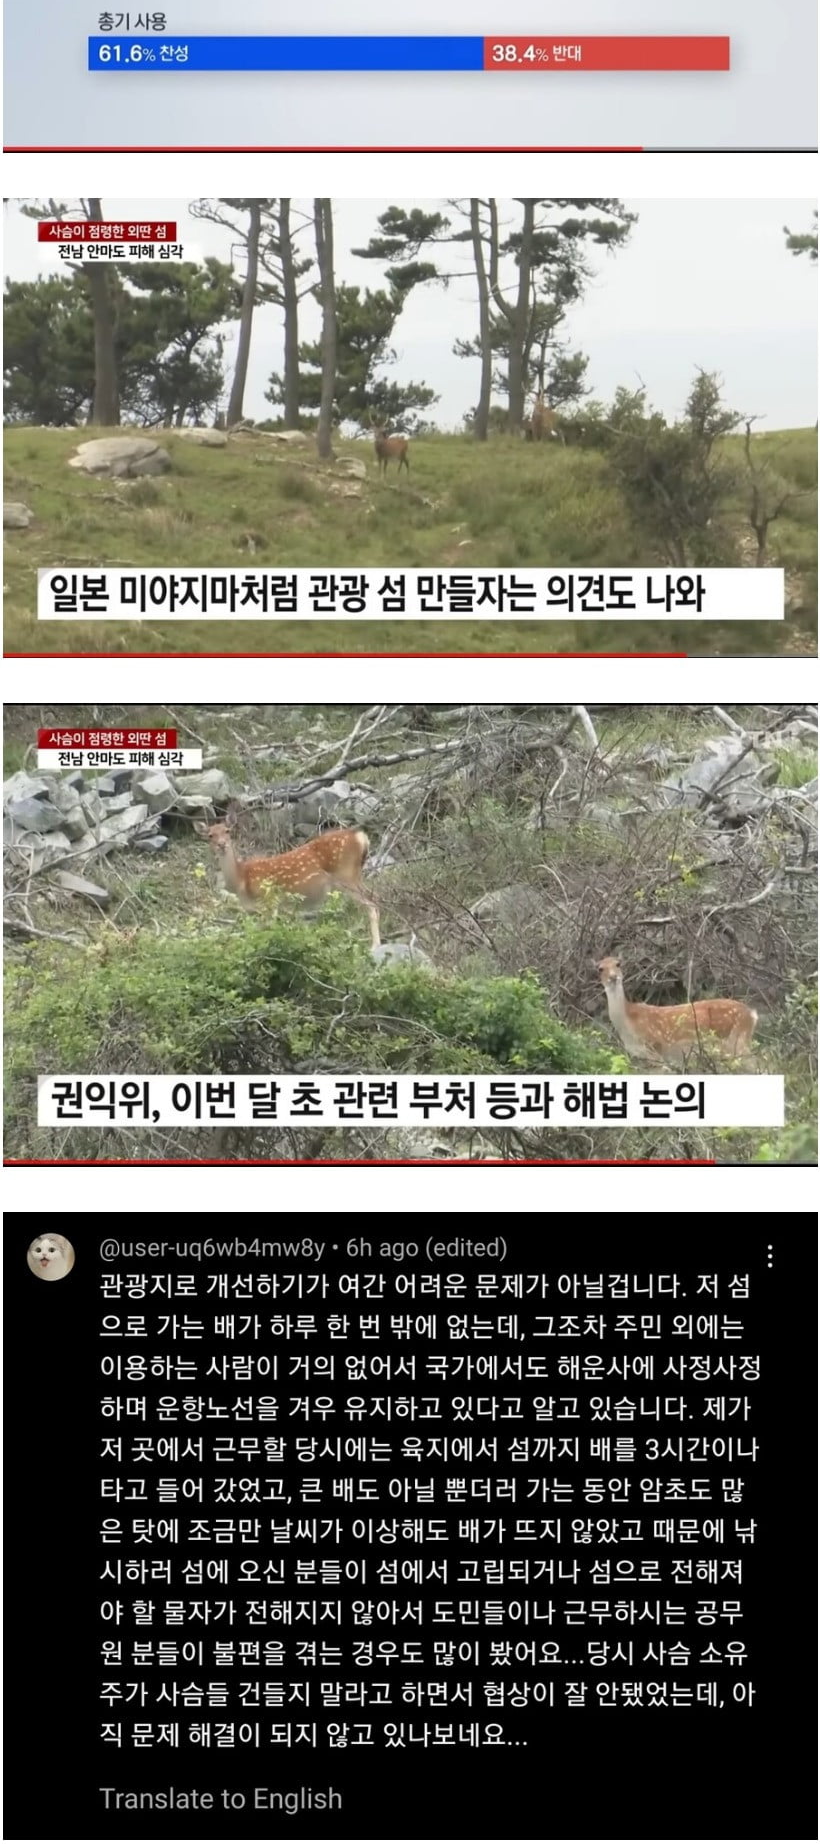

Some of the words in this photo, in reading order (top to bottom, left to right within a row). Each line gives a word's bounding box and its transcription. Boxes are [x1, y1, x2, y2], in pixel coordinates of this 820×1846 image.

[98, 11, 130, 32] 총기
[134, 12, 167, 32] 사용
[97, 44, 156, 63] 61.6%
[159, 44, 189, 63] 찬성
[492, 44, 549, 63] 38.4%
[552, 45, 582, 62] 반대
[99, 1236, 326, 1262] @user-uq6wb4mw8y
[346, 1236, 372, 1257] 6h
[379, 1242, 419, 1262] ago
[425, 1235, 508, 1262] (edited)
[99, 1273, 198, 1300] 관광지로
[206, 1273, 330, 1299] 개선하기가
[338, 1273, 387, 1299] 여간
[394, 1273, 468, 1299] 어려운
[475, 1273, 550, 1299] 문제가
[557, 1273, 687, 1299] 아닐겁니다.
[696, 1273, 718, 1299] 저
[727, 1273, 750, 1299] 섬
[99, 1722, 122, 1748] 직
[130, 1722, 179, 1748] 문제
[188, 1722, 260, 1748] 해결이
[270, 1722, 317, 1748] 되지
[326, 1722, 375, 1749] 않고
[98, 1786, 214, 1810] Translate
[220, 1788, 246, 1810] to
[254, 1786, 343, 1816] English
